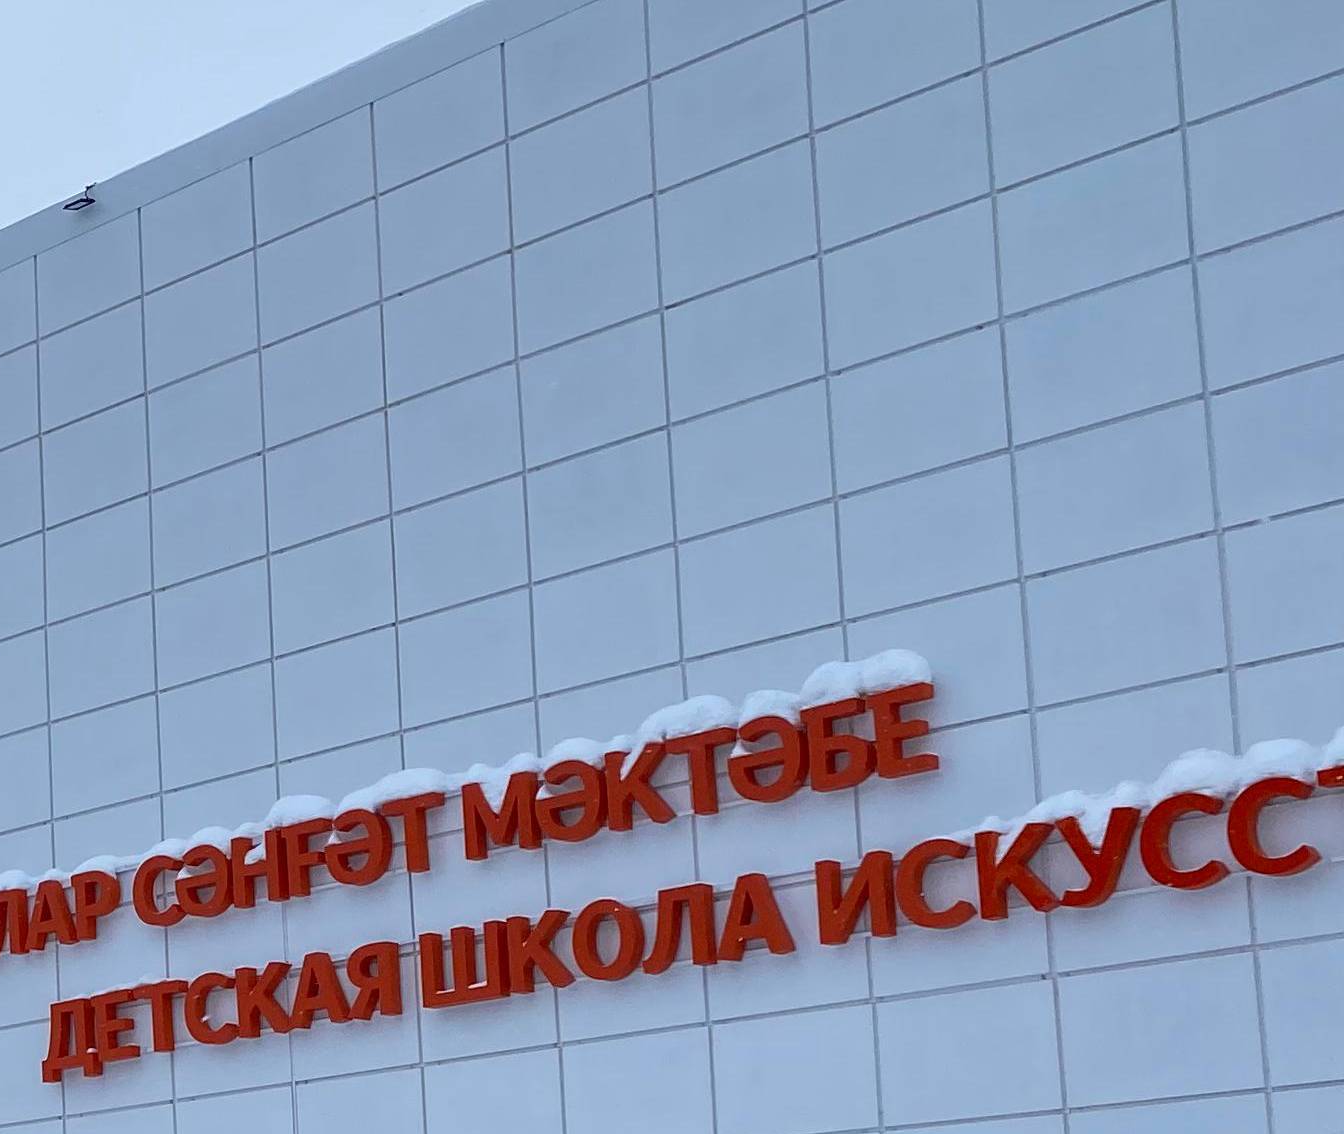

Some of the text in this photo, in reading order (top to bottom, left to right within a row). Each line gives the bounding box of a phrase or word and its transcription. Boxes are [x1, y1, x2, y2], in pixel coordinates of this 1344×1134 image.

[132, 792, 445, 927] СӘНҒӘТ
[461, 682, 939, 860] МӘКТӘБЕ
[41, 941, 403, 1083] ДЕТСКАЯ
[419, 873, 795, 1009] ШКОЛА
